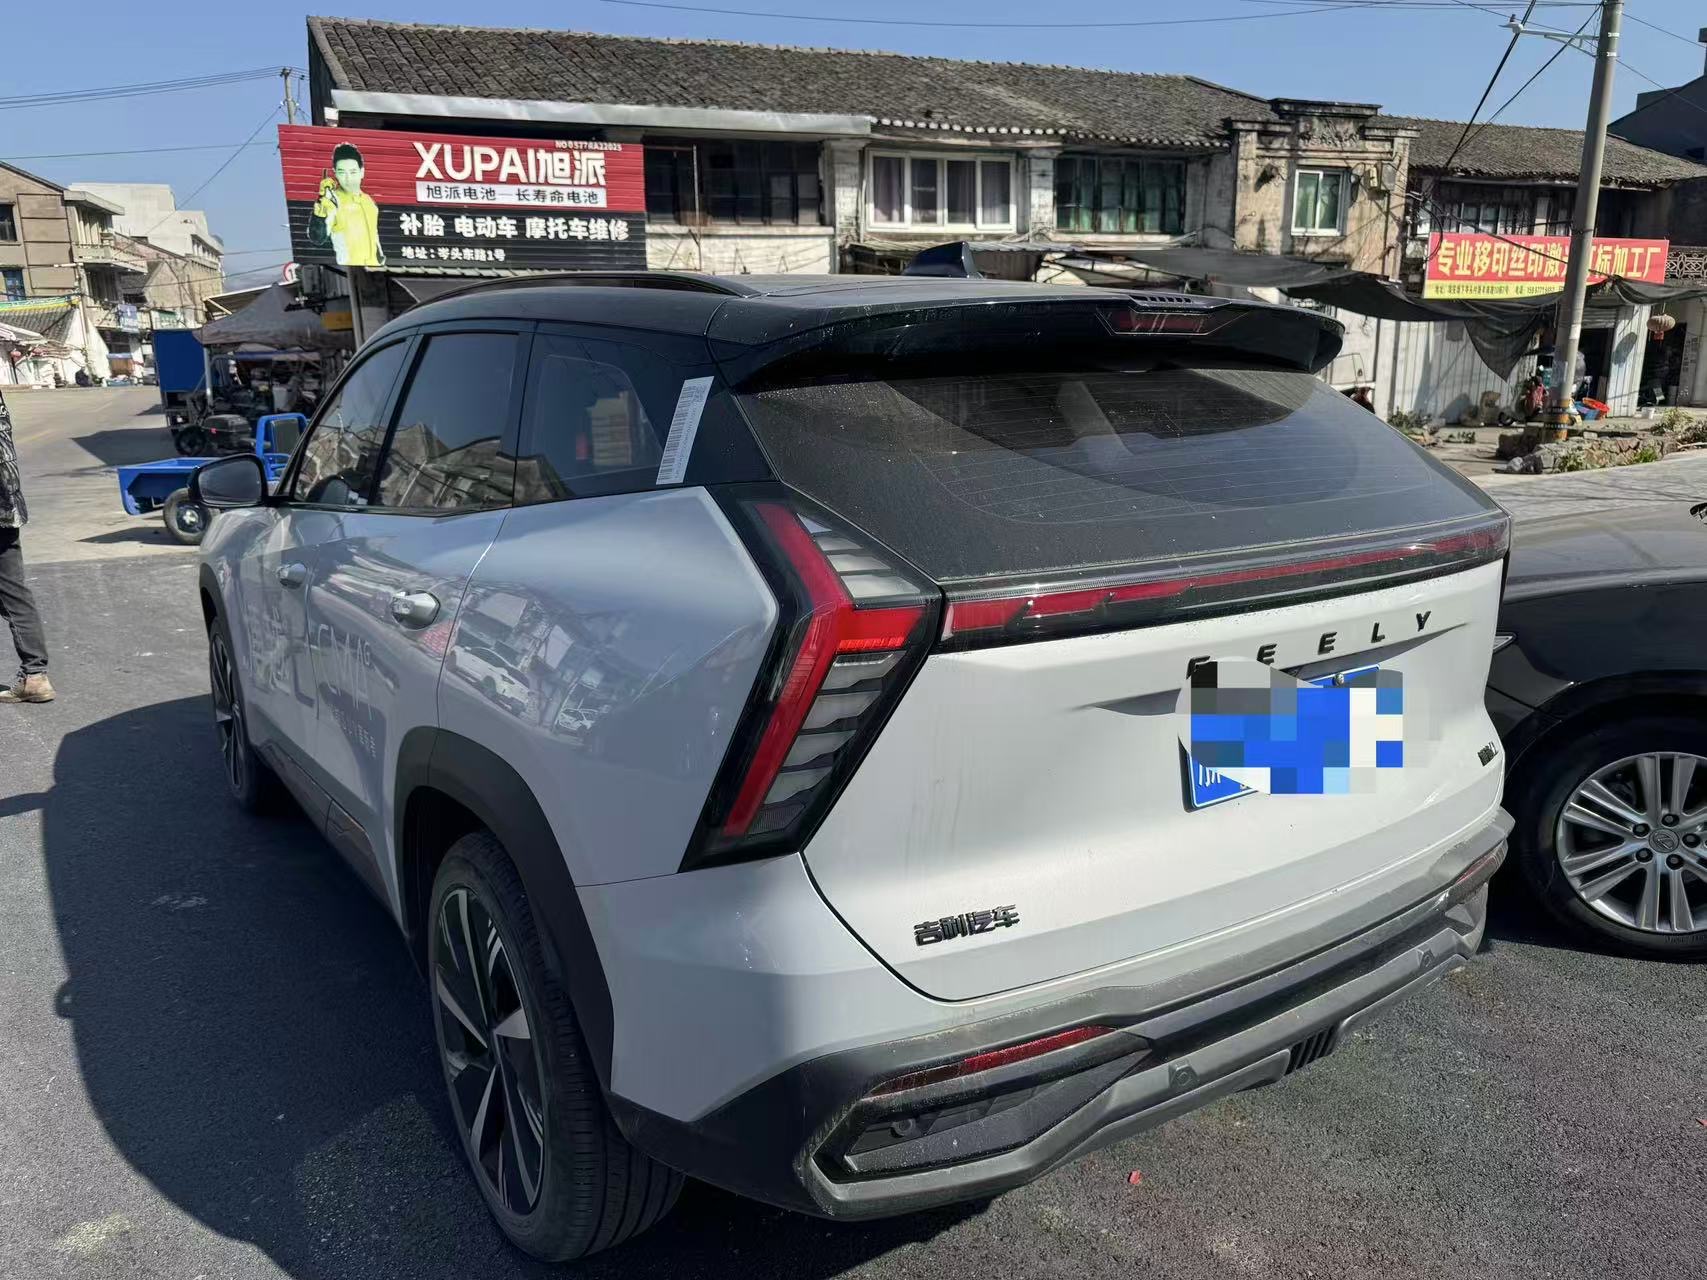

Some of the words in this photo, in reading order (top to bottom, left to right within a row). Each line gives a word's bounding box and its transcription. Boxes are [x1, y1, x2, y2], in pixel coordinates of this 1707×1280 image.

[399, 213, 445, 236] 补胎
[454, 215, 518, 239] 电动车
[525, 217, 629, 240] 摩托车维修
[1437, 239, 1661, 279] 专业移印丝印激标加工厂
[914, 904, 1020, 947] 吉利汽车
